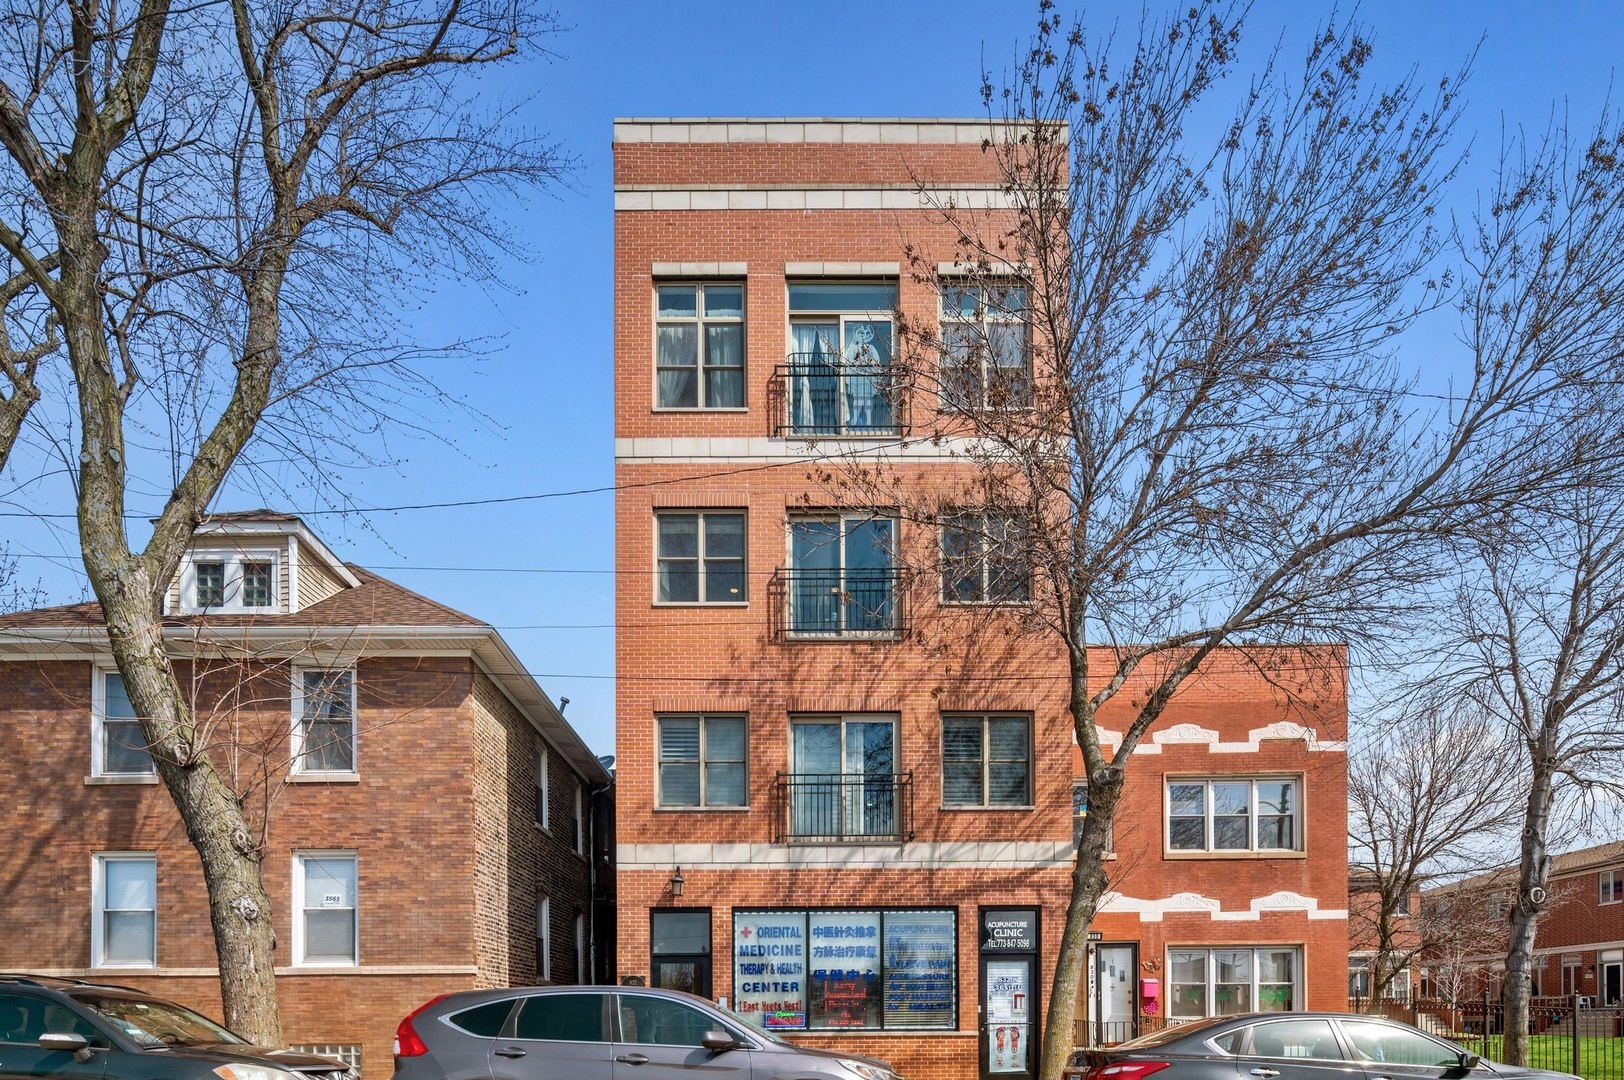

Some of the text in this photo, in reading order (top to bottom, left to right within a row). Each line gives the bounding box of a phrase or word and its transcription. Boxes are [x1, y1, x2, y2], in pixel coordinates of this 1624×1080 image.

[757, 926, 802, 938] ORIENTAL
[813, 926, 876, 938] 中医针灸推拿
[889, 925, 950, 933] ACUPUNCTURE
[994, 929, 1024, 937] CLINIC
[740, 945, 802, 957] MEDICINE
[740, 963, 802, 975] THERAPY & HEALTH
[742, 982, 799, 992] CENTER
[762, 1001, 782, 1012] Meets
